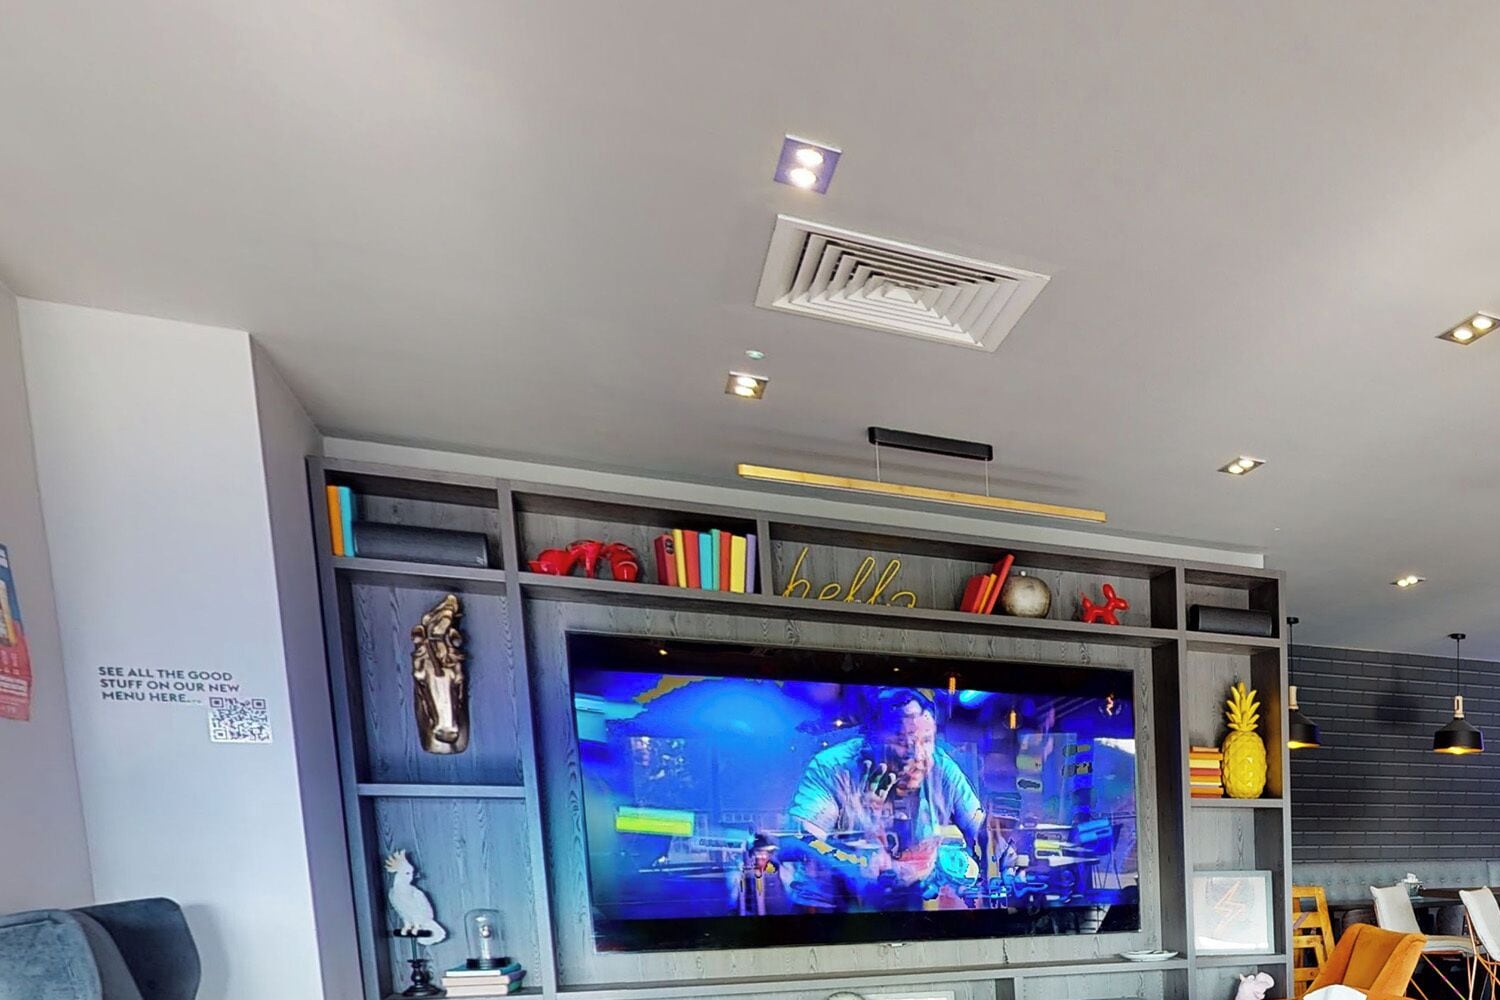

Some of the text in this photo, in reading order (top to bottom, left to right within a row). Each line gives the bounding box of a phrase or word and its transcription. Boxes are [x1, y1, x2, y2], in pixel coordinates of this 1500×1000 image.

[98, 666, 232, 681] SEE ALL THE GOOD
[100, 679, 240, 693] STUFF ON OUR NEW
[102, 691, 145, 701] MENU
